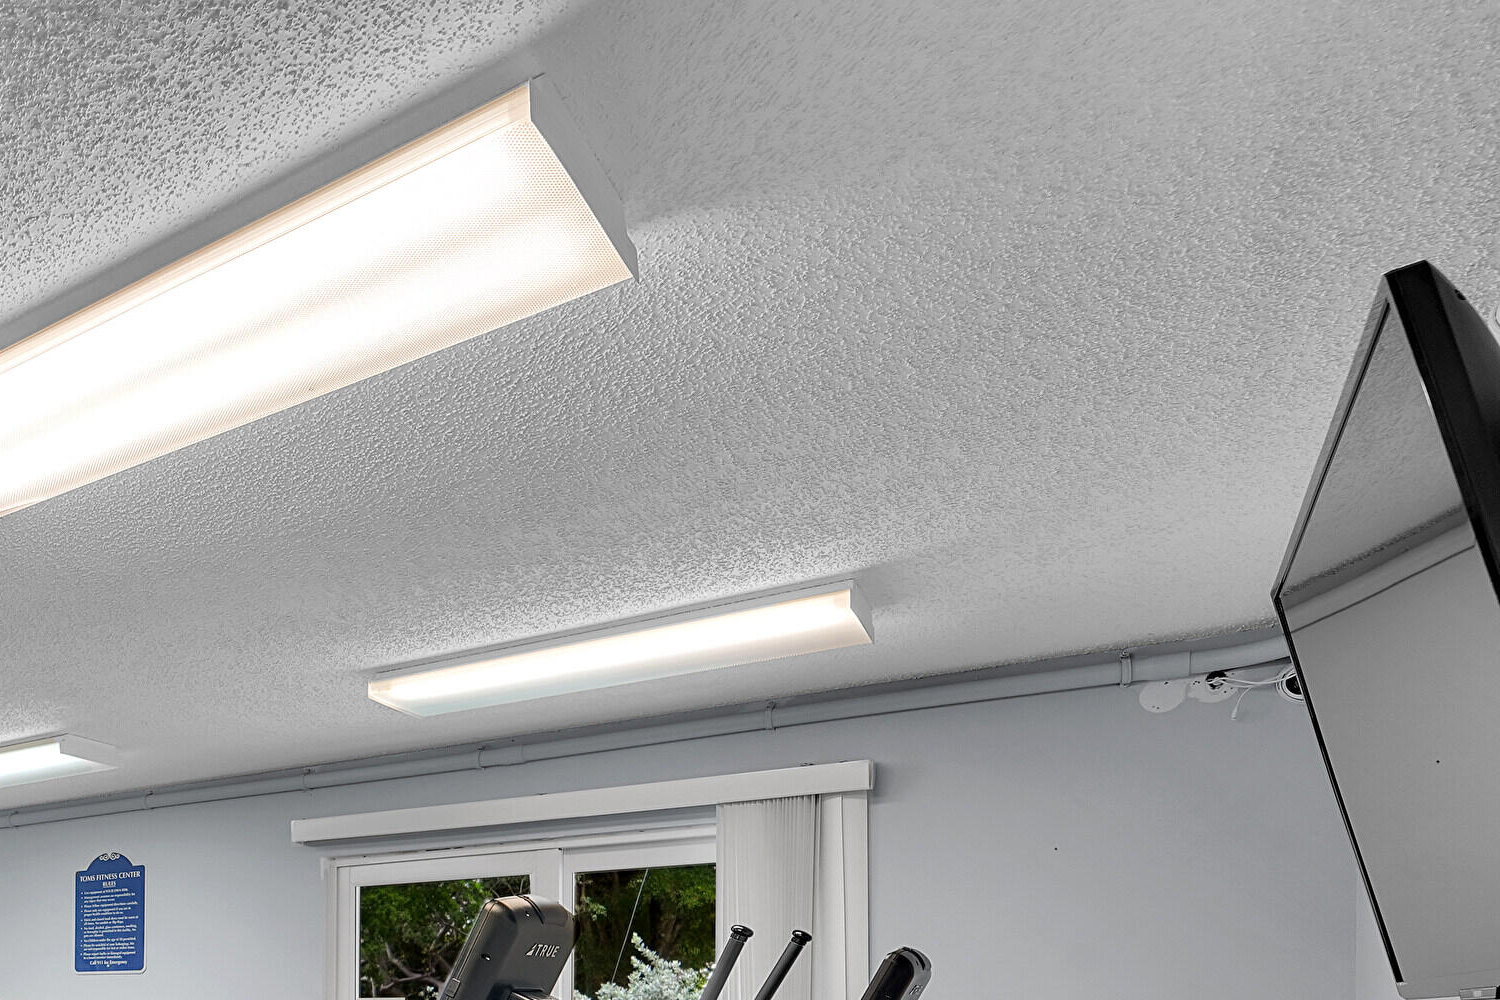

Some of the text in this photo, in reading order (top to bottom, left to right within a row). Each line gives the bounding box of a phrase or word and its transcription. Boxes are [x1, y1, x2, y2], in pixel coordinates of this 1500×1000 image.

[97, 872, 117, 881] FITNESS
[119, 870, 140, 879] CENTER
[535, 944, 560, 958] TRUE
